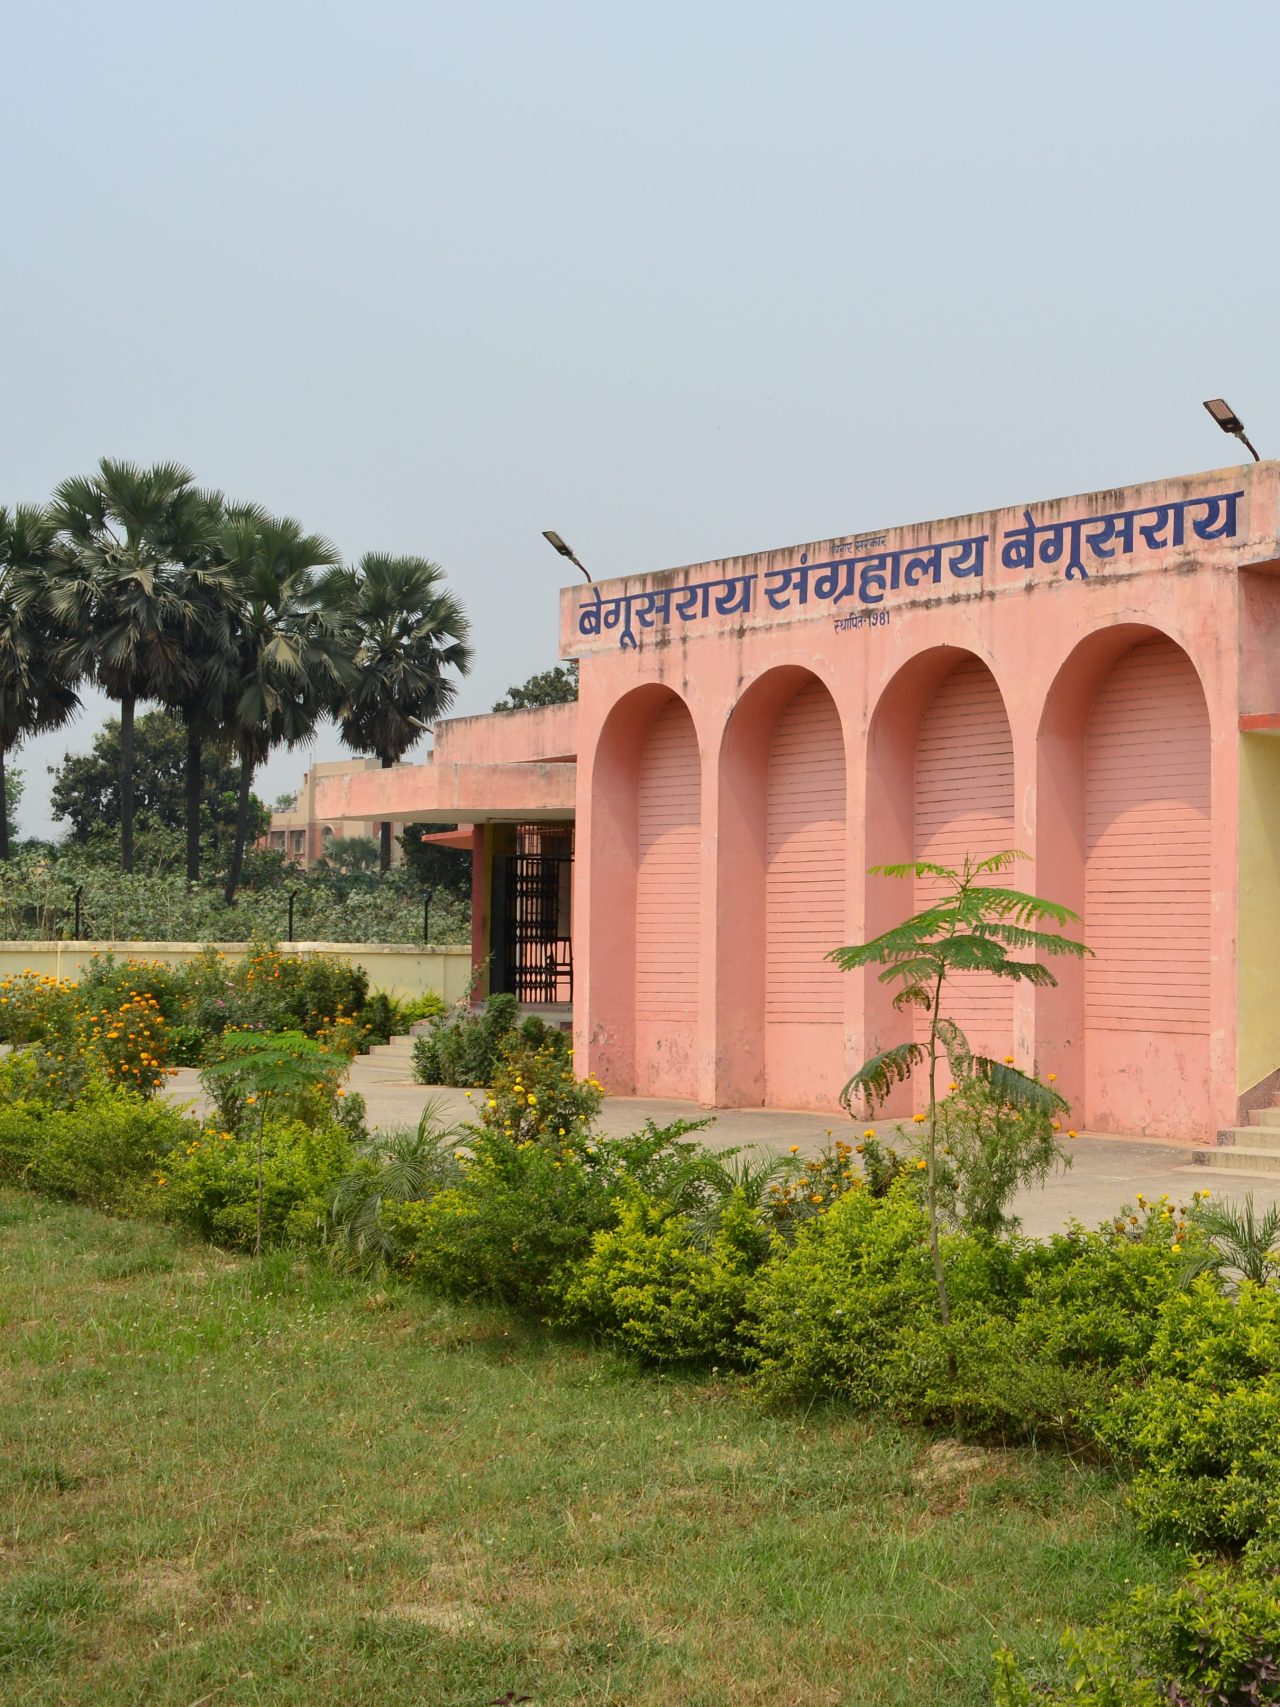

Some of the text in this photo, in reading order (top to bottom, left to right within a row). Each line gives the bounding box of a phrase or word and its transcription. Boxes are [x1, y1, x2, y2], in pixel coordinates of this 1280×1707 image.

[578, 490, 1244, 650] बेगूसराय संग्रहालय बेगूसराय
